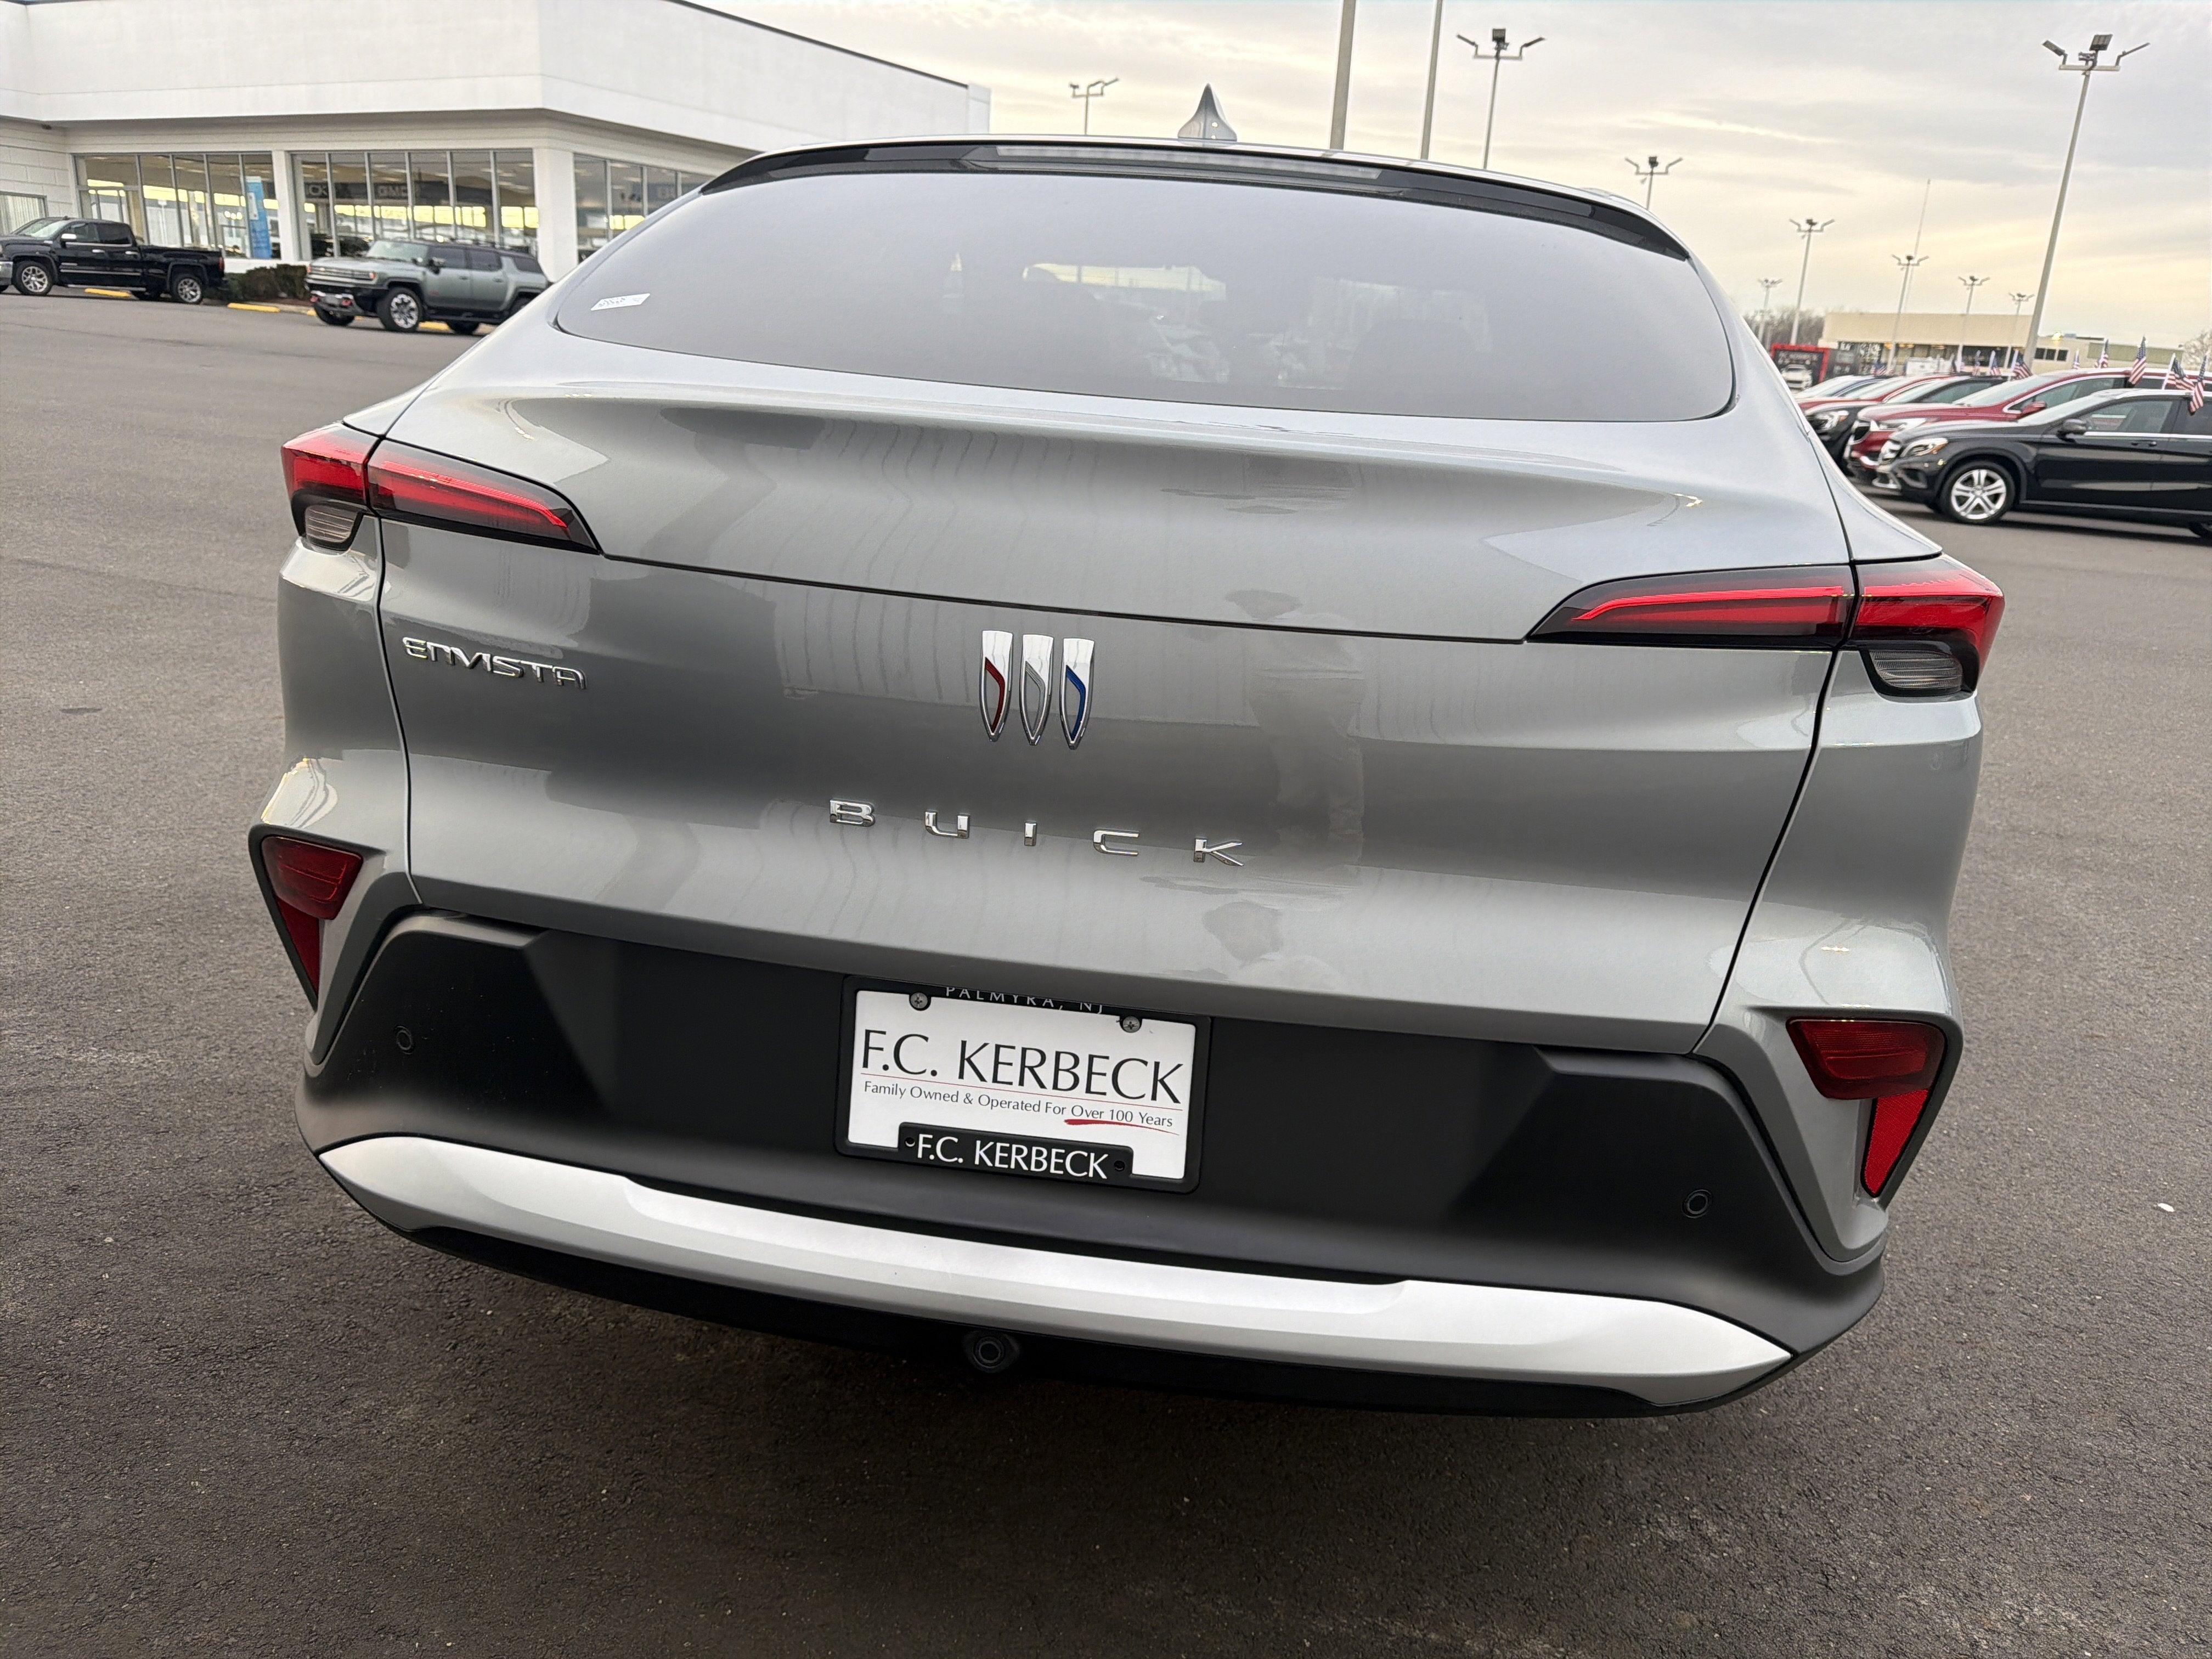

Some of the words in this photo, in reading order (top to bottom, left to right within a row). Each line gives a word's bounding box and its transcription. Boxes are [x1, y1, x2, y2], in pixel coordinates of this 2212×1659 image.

[402, 636, 588, 690] ENVISTA
[830, 798, 1244, 867] BUICK
[1080, 1002, 1103, 1014] NJ
[862, 1029, 938, 1077] F.C.
[958, 1040, 1184, 1104] KERBECK
[864, 1081, 906, 1099] Family
[910, 1086, 959, 1103] Owned
[963, 1092, 974, 1104] &
[978, 1094, 1041, 1113] Operated
[1045, 1102, 1066, 1115] For
[1071, 1105, 1104, 1119] Over
[1109, 1109, 1133, 1122] 100
[1138, 1111, 1173, 1127] Years
[917, 1133, 964, 1164] F.C.
[974, 1140, 1109, 1180] KERBECK
